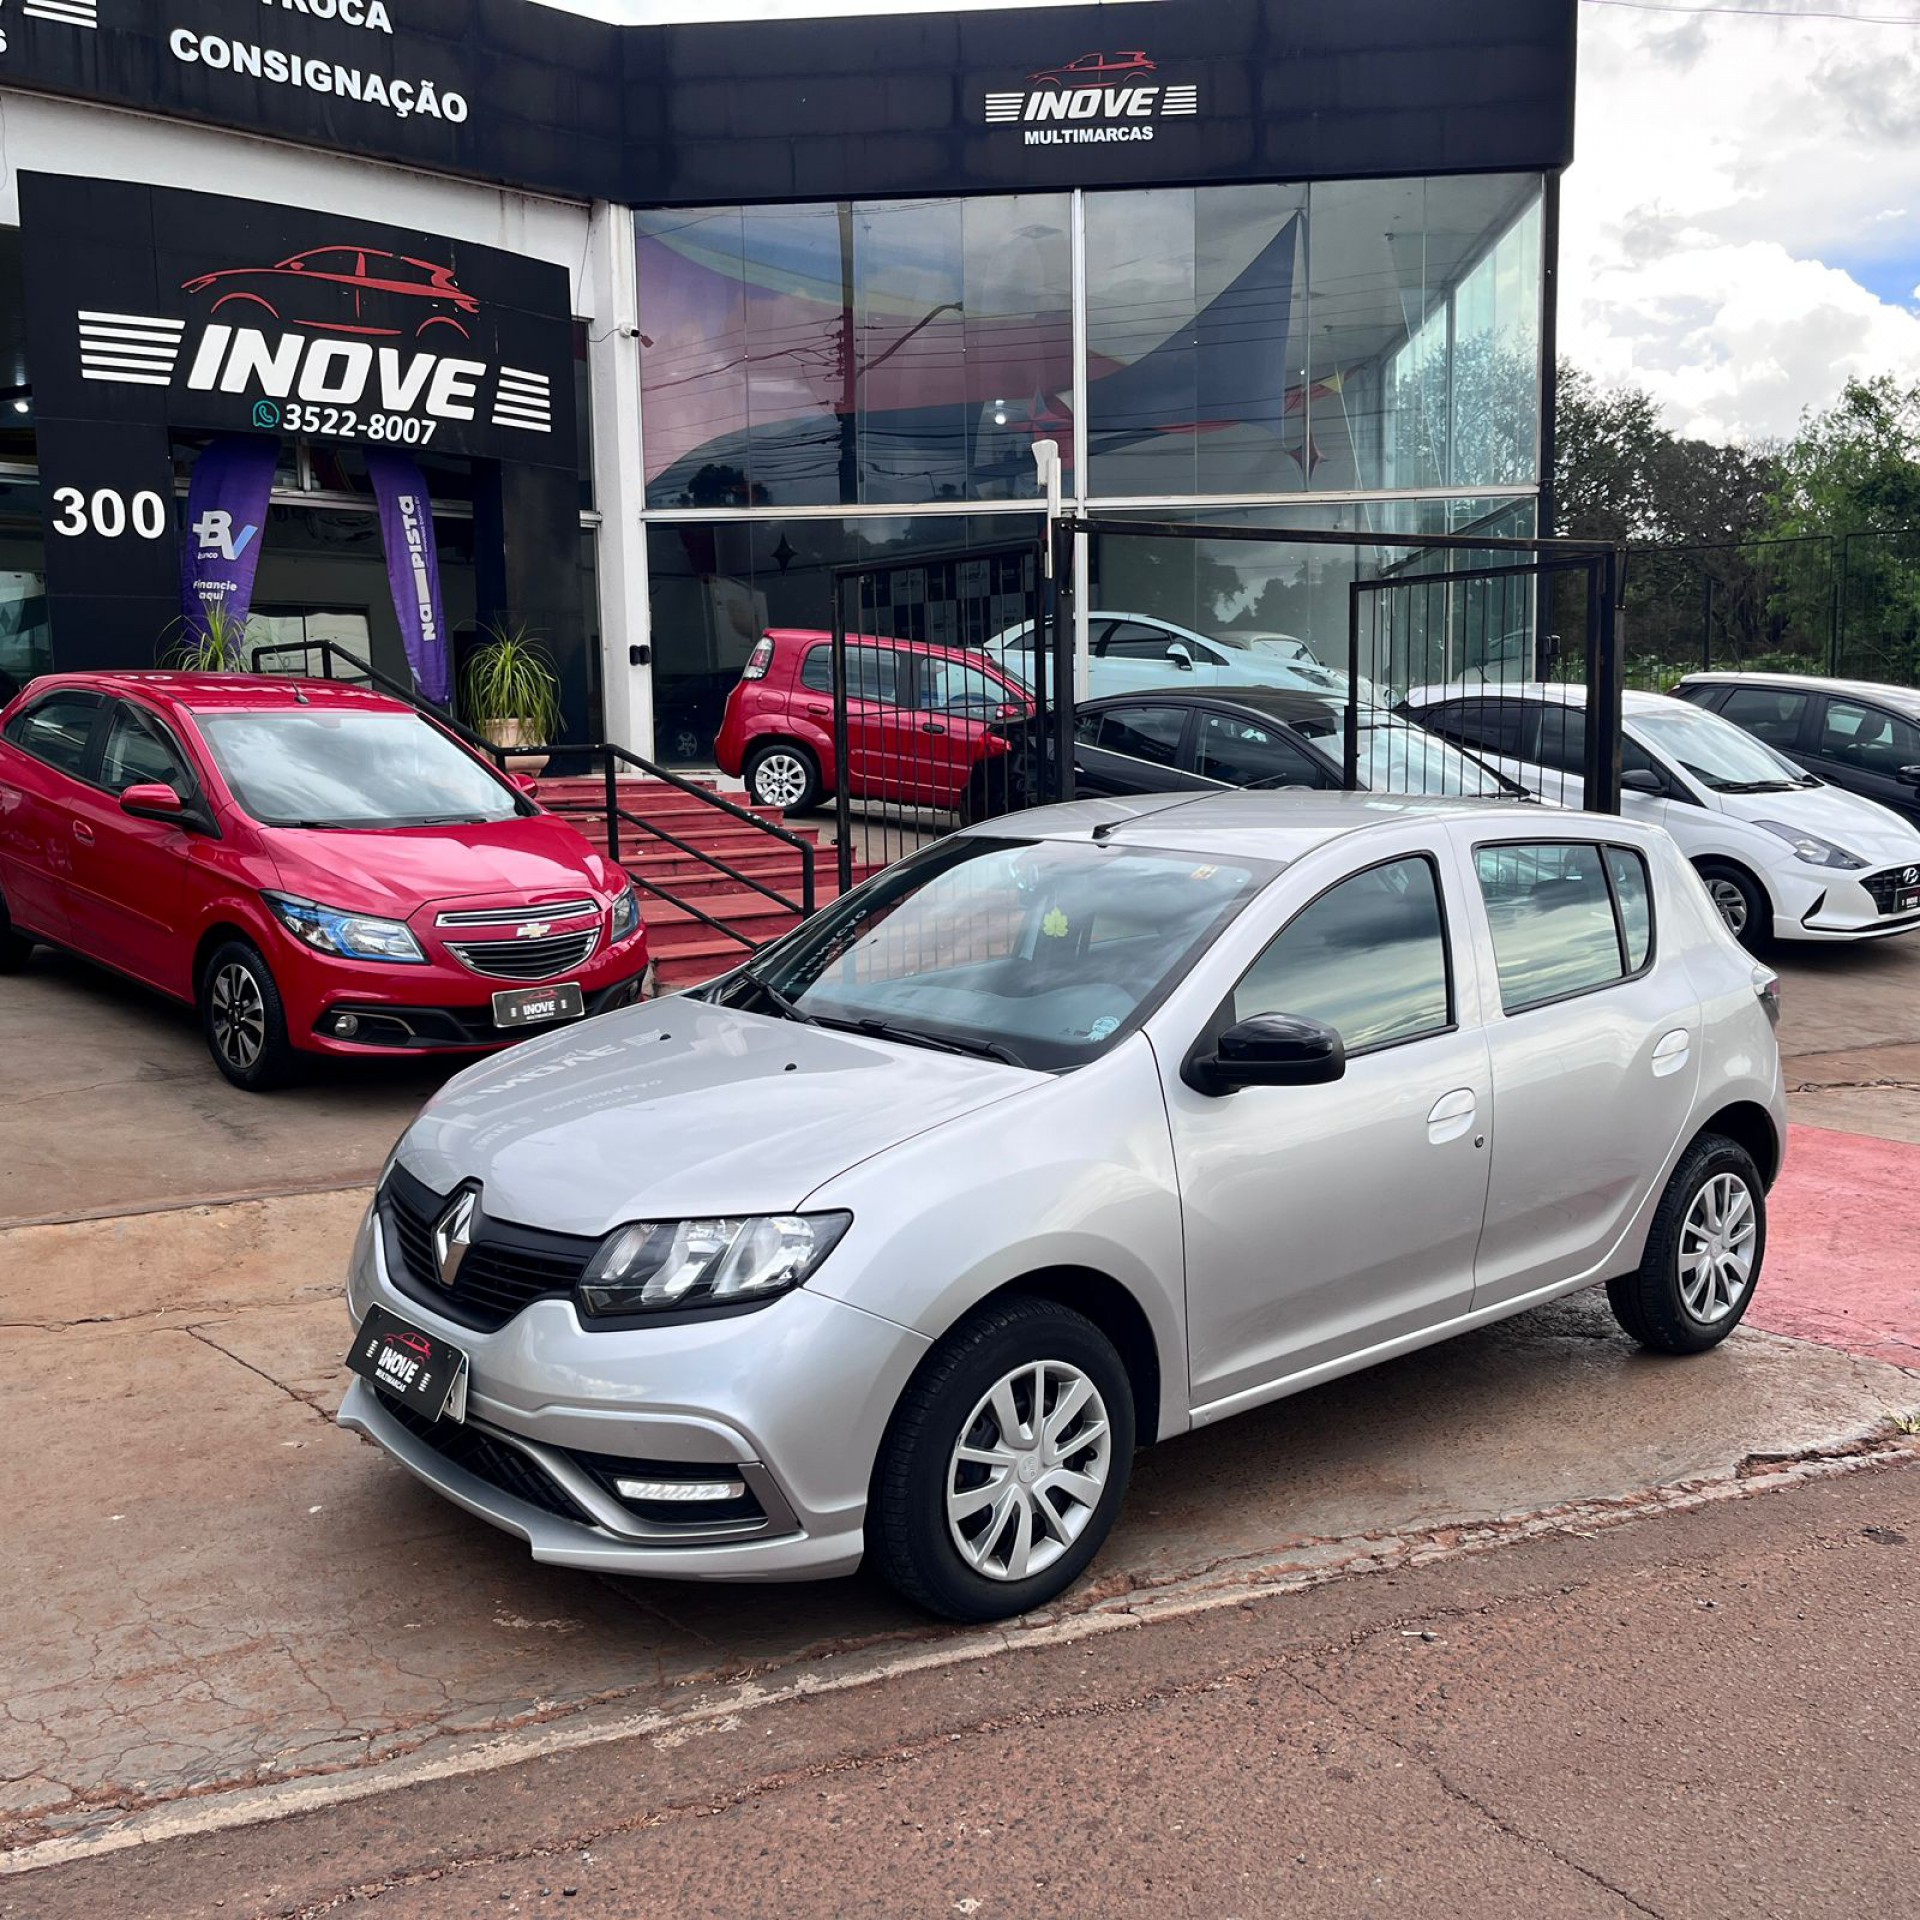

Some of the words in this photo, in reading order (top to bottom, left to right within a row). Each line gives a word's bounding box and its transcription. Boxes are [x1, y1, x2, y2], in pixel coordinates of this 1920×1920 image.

[261, 0, 393, 34] OCA
[169, 28, 468, 123] CONSIGNAÇÃO
[1023, 86, 1160, 121] INOVE
[1024, 126, 1154, 145] MULTIMARCAS
[187, 324, 487, 421] INOVE
[282, 403, 437, 445] 3522-8007
[52, 486, 166, 539] 300
[198, 590, 224, 602] aqui
[523, 1000, 556, 1015] INOVE
[378, 1345, 420, 1384] INOVE
